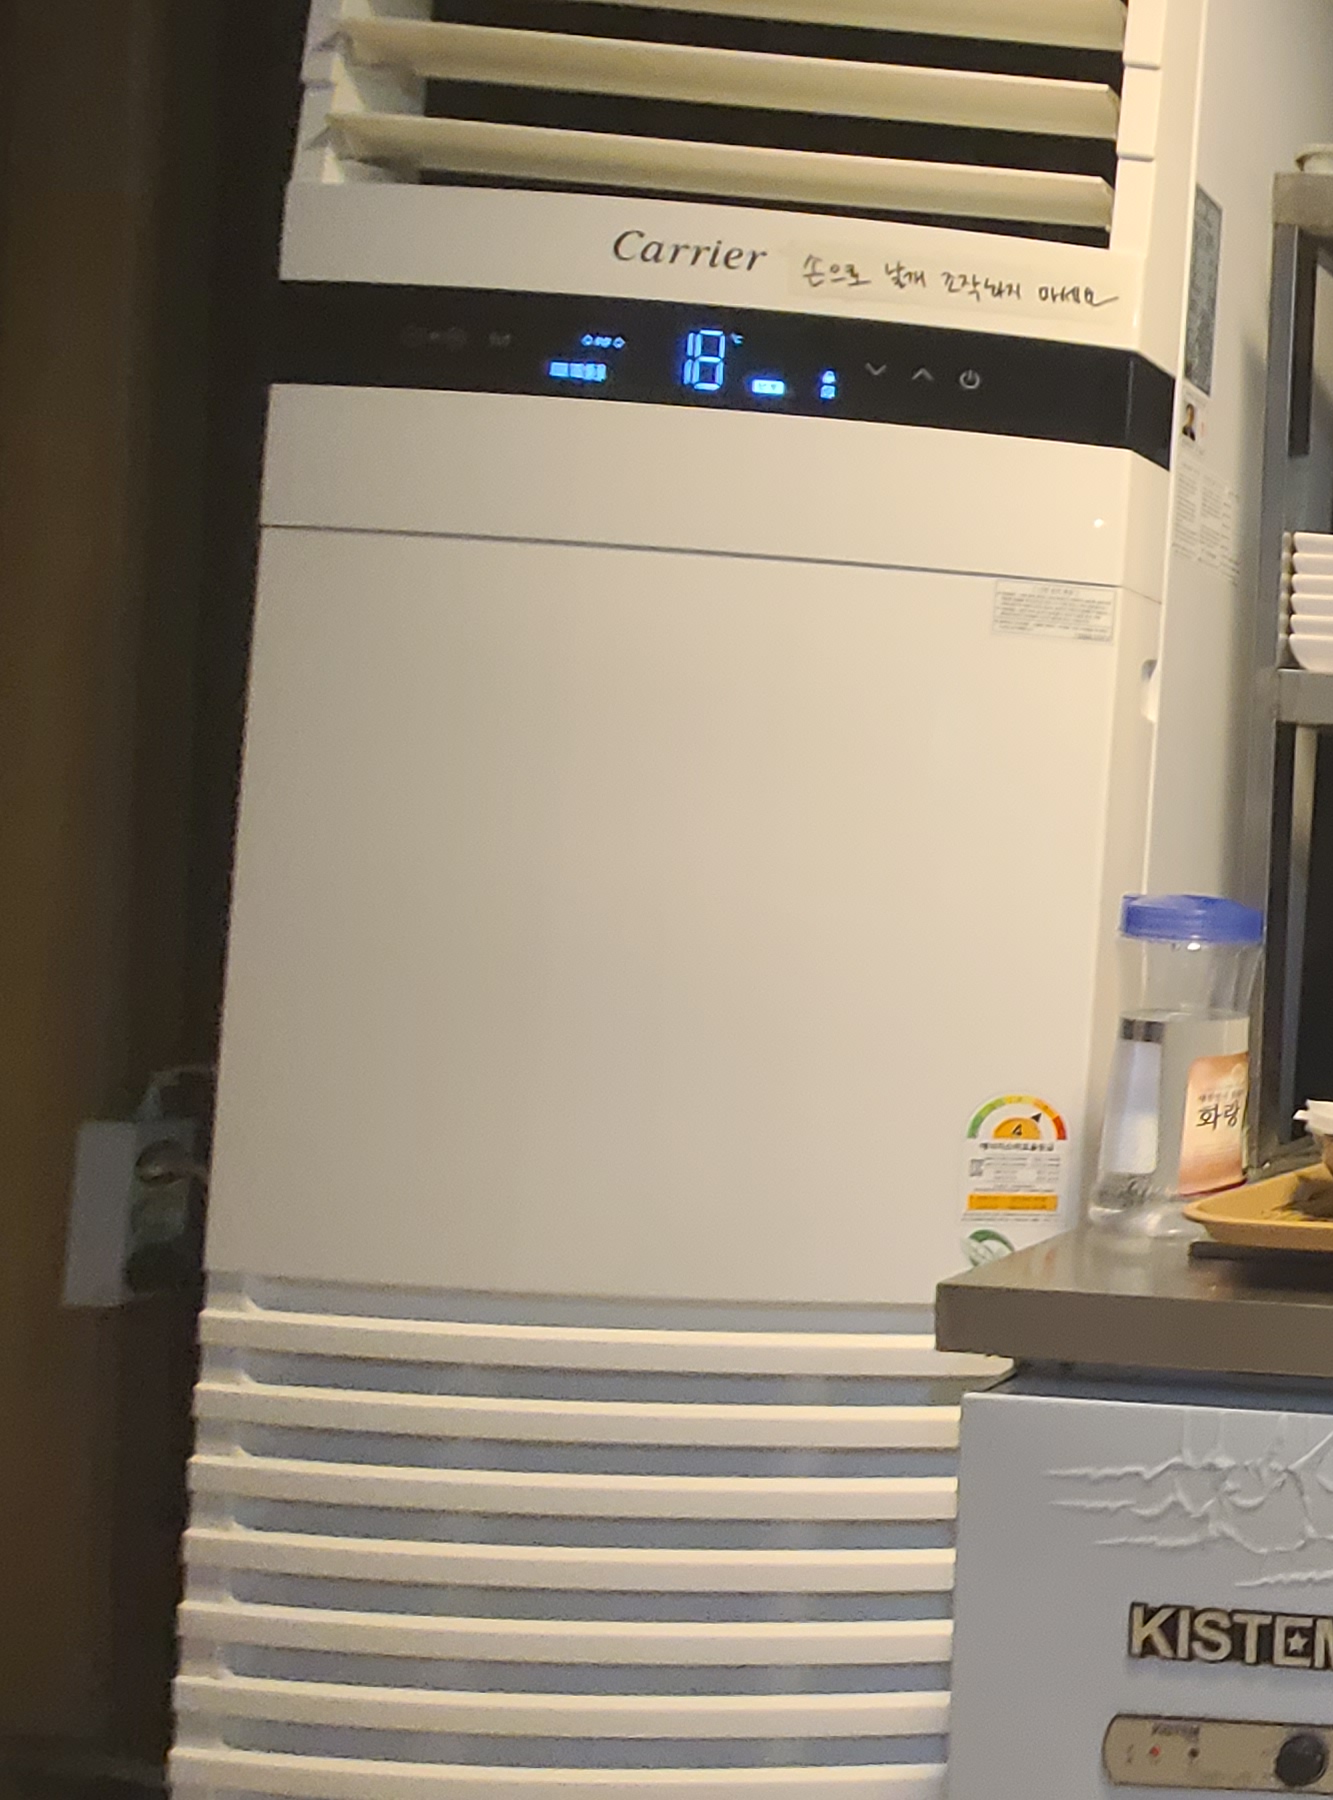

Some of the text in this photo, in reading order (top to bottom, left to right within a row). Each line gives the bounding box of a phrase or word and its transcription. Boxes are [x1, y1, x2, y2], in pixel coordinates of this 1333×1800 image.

[613, 229, 768, 271] Carrier
[803, 254, 872, 287] 손으로
[683, 329, 726, 392] 18
[1195, 1099, 1241, 1131] 화랑
